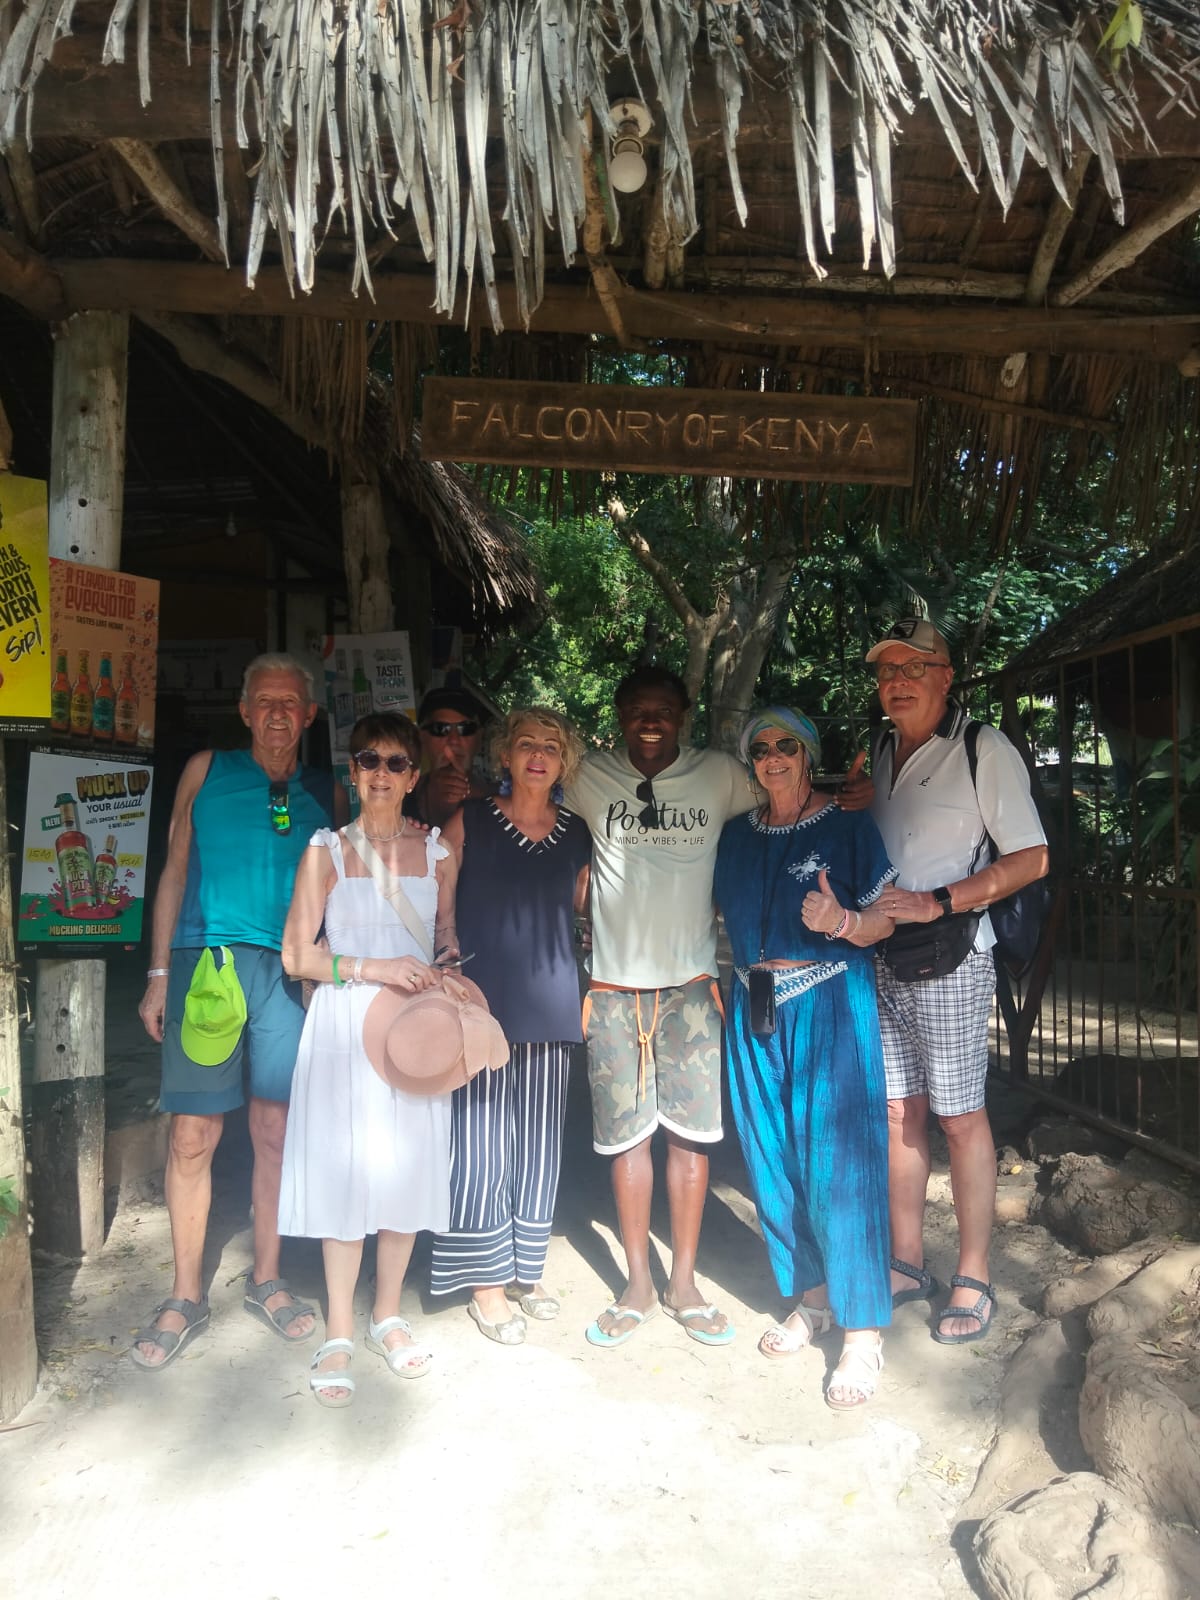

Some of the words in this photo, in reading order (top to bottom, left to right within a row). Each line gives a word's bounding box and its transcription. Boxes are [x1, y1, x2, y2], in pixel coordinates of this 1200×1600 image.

[451, 400, 679, 446] FALCONRY
[682, 413, 729, 449] OF
[737, 415, 876, 456] KENYA
[0, 546, 9, 563] H
[76, 569, 116, 593] FLAVOUR
[119, 578, 136, 597] FOR
[376, 664, 404, 677] TASTE
[76, 772, 127, 803] MUCK
[127, 769, 150, 797] UP
[87, 803, 112, 813] YOUR
[113, 797, 142, 810] usual
[606, 800, 709, 839] Potive
[615, 836, 639, 845] MIND
[652, 836, 677, 845] VIBES
[689, 836, 705, 845] LIFE
[85, 924, 121, 935] DELICIOUS
